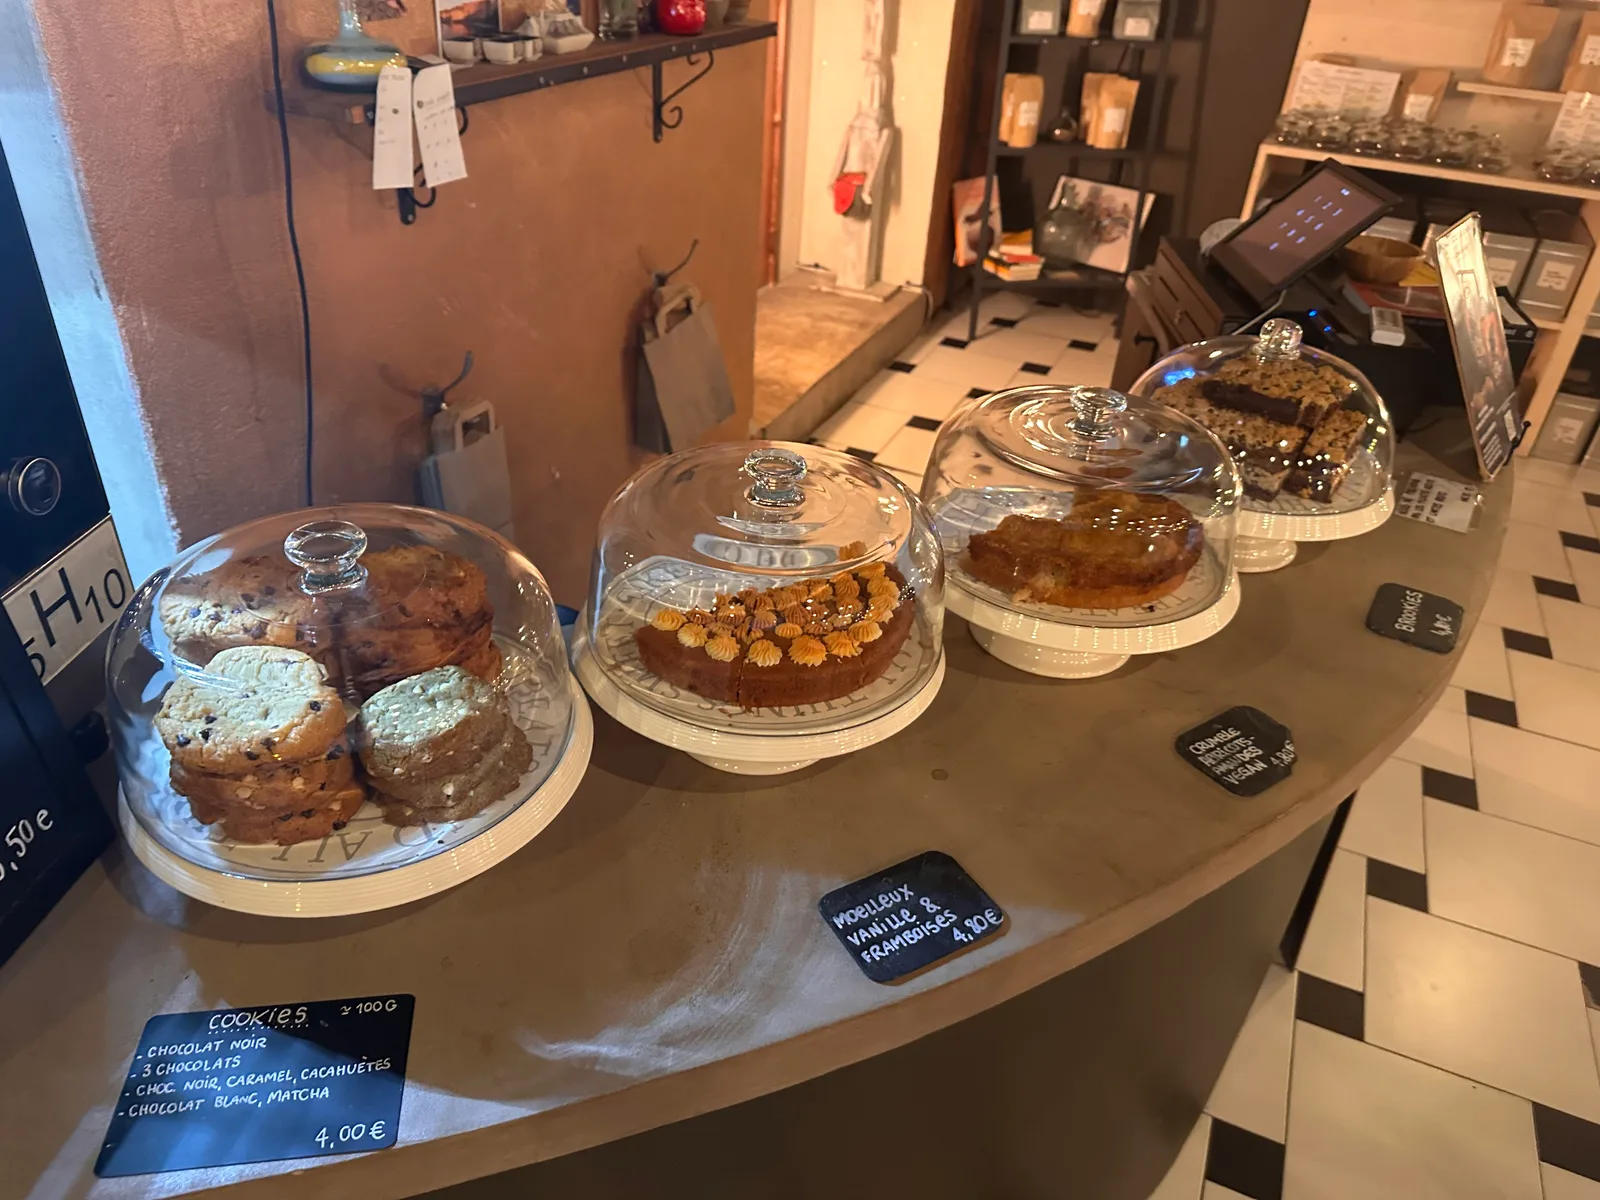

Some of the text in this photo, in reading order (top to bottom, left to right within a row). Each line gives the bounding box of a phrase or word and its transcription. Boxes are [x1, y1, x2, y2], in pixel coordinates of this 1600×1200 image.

[1189, 727, 1241, 754] CRUMBLE
[1222, 759, 1268, 785] VEGAN
[919, 896, 941, 913] &
[147, 1040, 224, 1058] CHOCOLAT
[142, 1063, 151, 1078] 3
[156, 1055, 241, 1076] CHOCOLATS
[136, 1082, 176, 1096] CHOC.
[226, 1070, 297, 1087] CARAMEL,
[128, 1099, 205, 1117] CHOCOLAT
[214, 1092, 262, 1108] BLANC,
[267, 1086, 330, 1104] MATCHA
